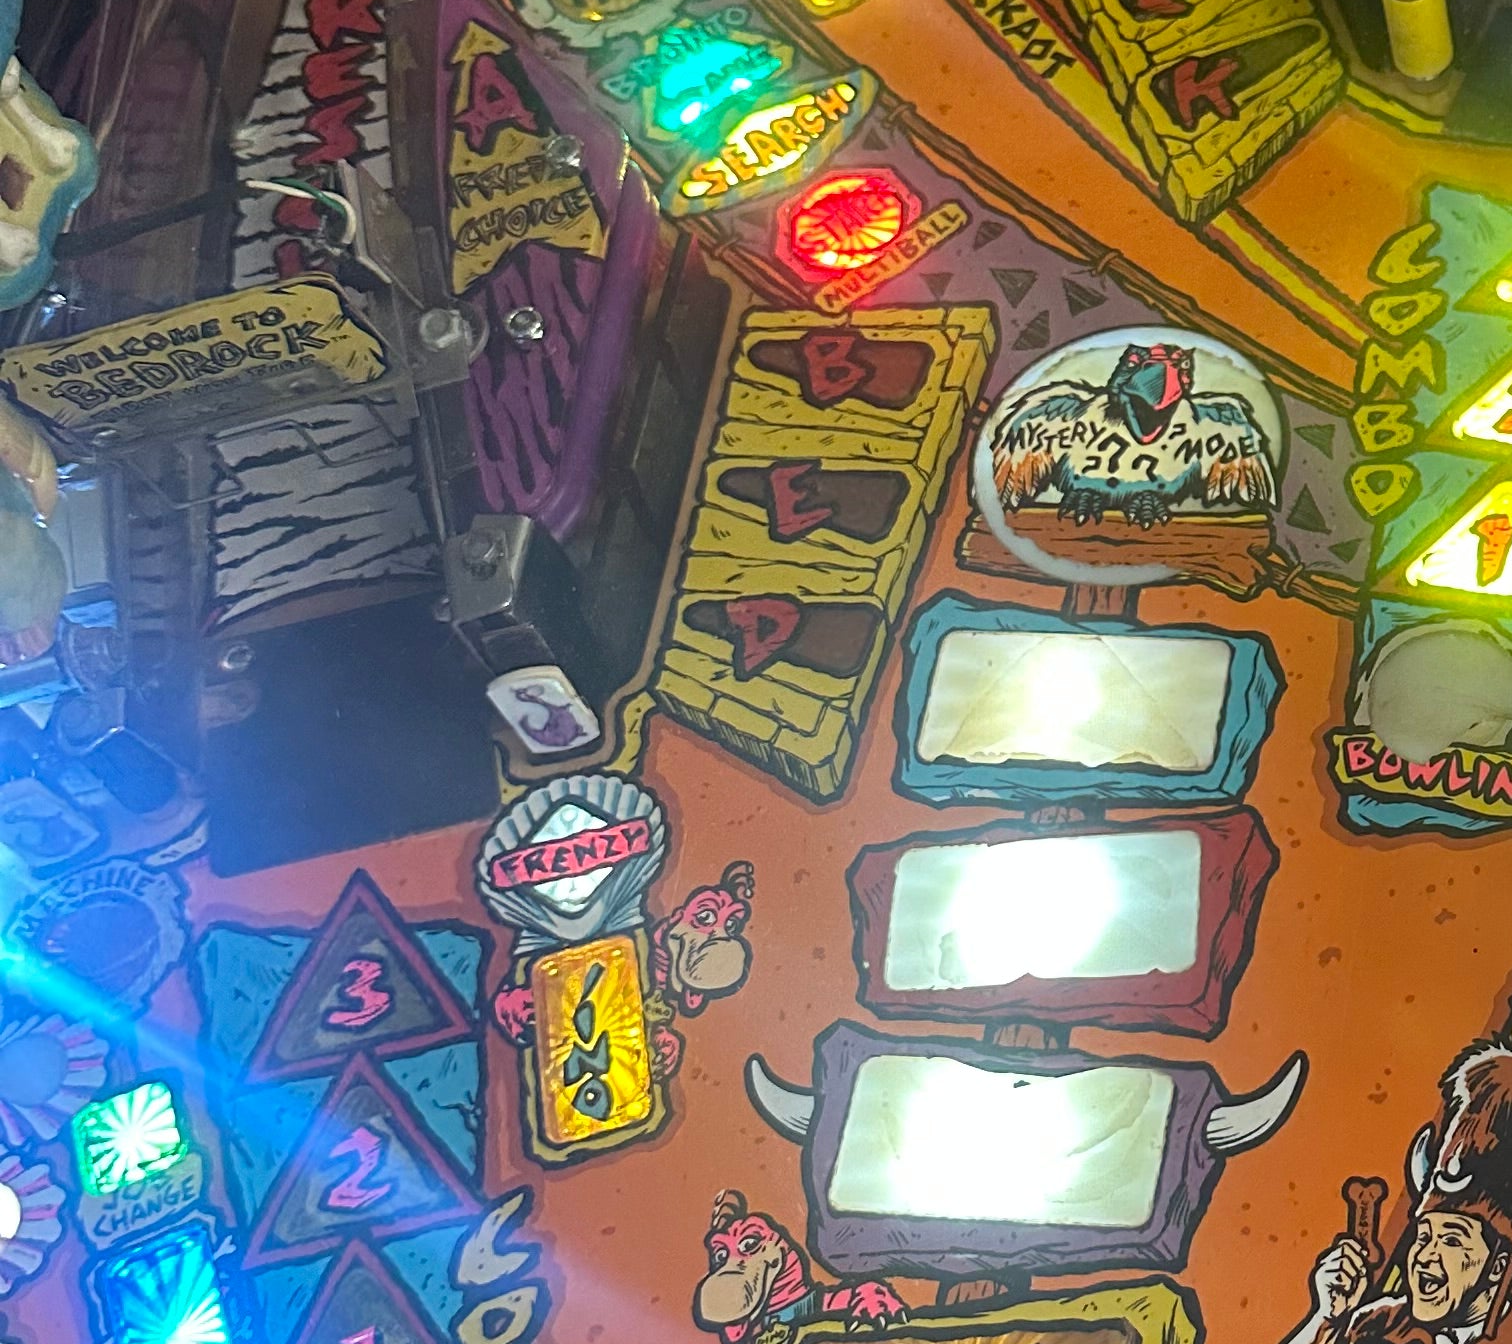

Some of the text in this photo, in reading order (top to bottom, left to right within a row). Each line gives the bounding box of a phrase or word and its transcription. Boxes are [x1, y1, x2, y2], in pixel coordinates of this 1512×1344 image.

[691, 89, 850, 196] SEARCH
[456, 186, 593, 253] CHOICE
[822, 207, 962, 308] MULTIBALL
[34, 306, 287, 379] WELCOME TO
[50, 320, 331, 412] BEDROCK
[1001, 419, 1107, 455] MYSTERY
[1171, 433, 1263, 464] MODE
[500, 826, 646, 879] FRENZY
[327, 956, 392, 1032] 3
[93, 1175, 197, 1237] CHANGE
[324, 1126, 392, 1213] 2
